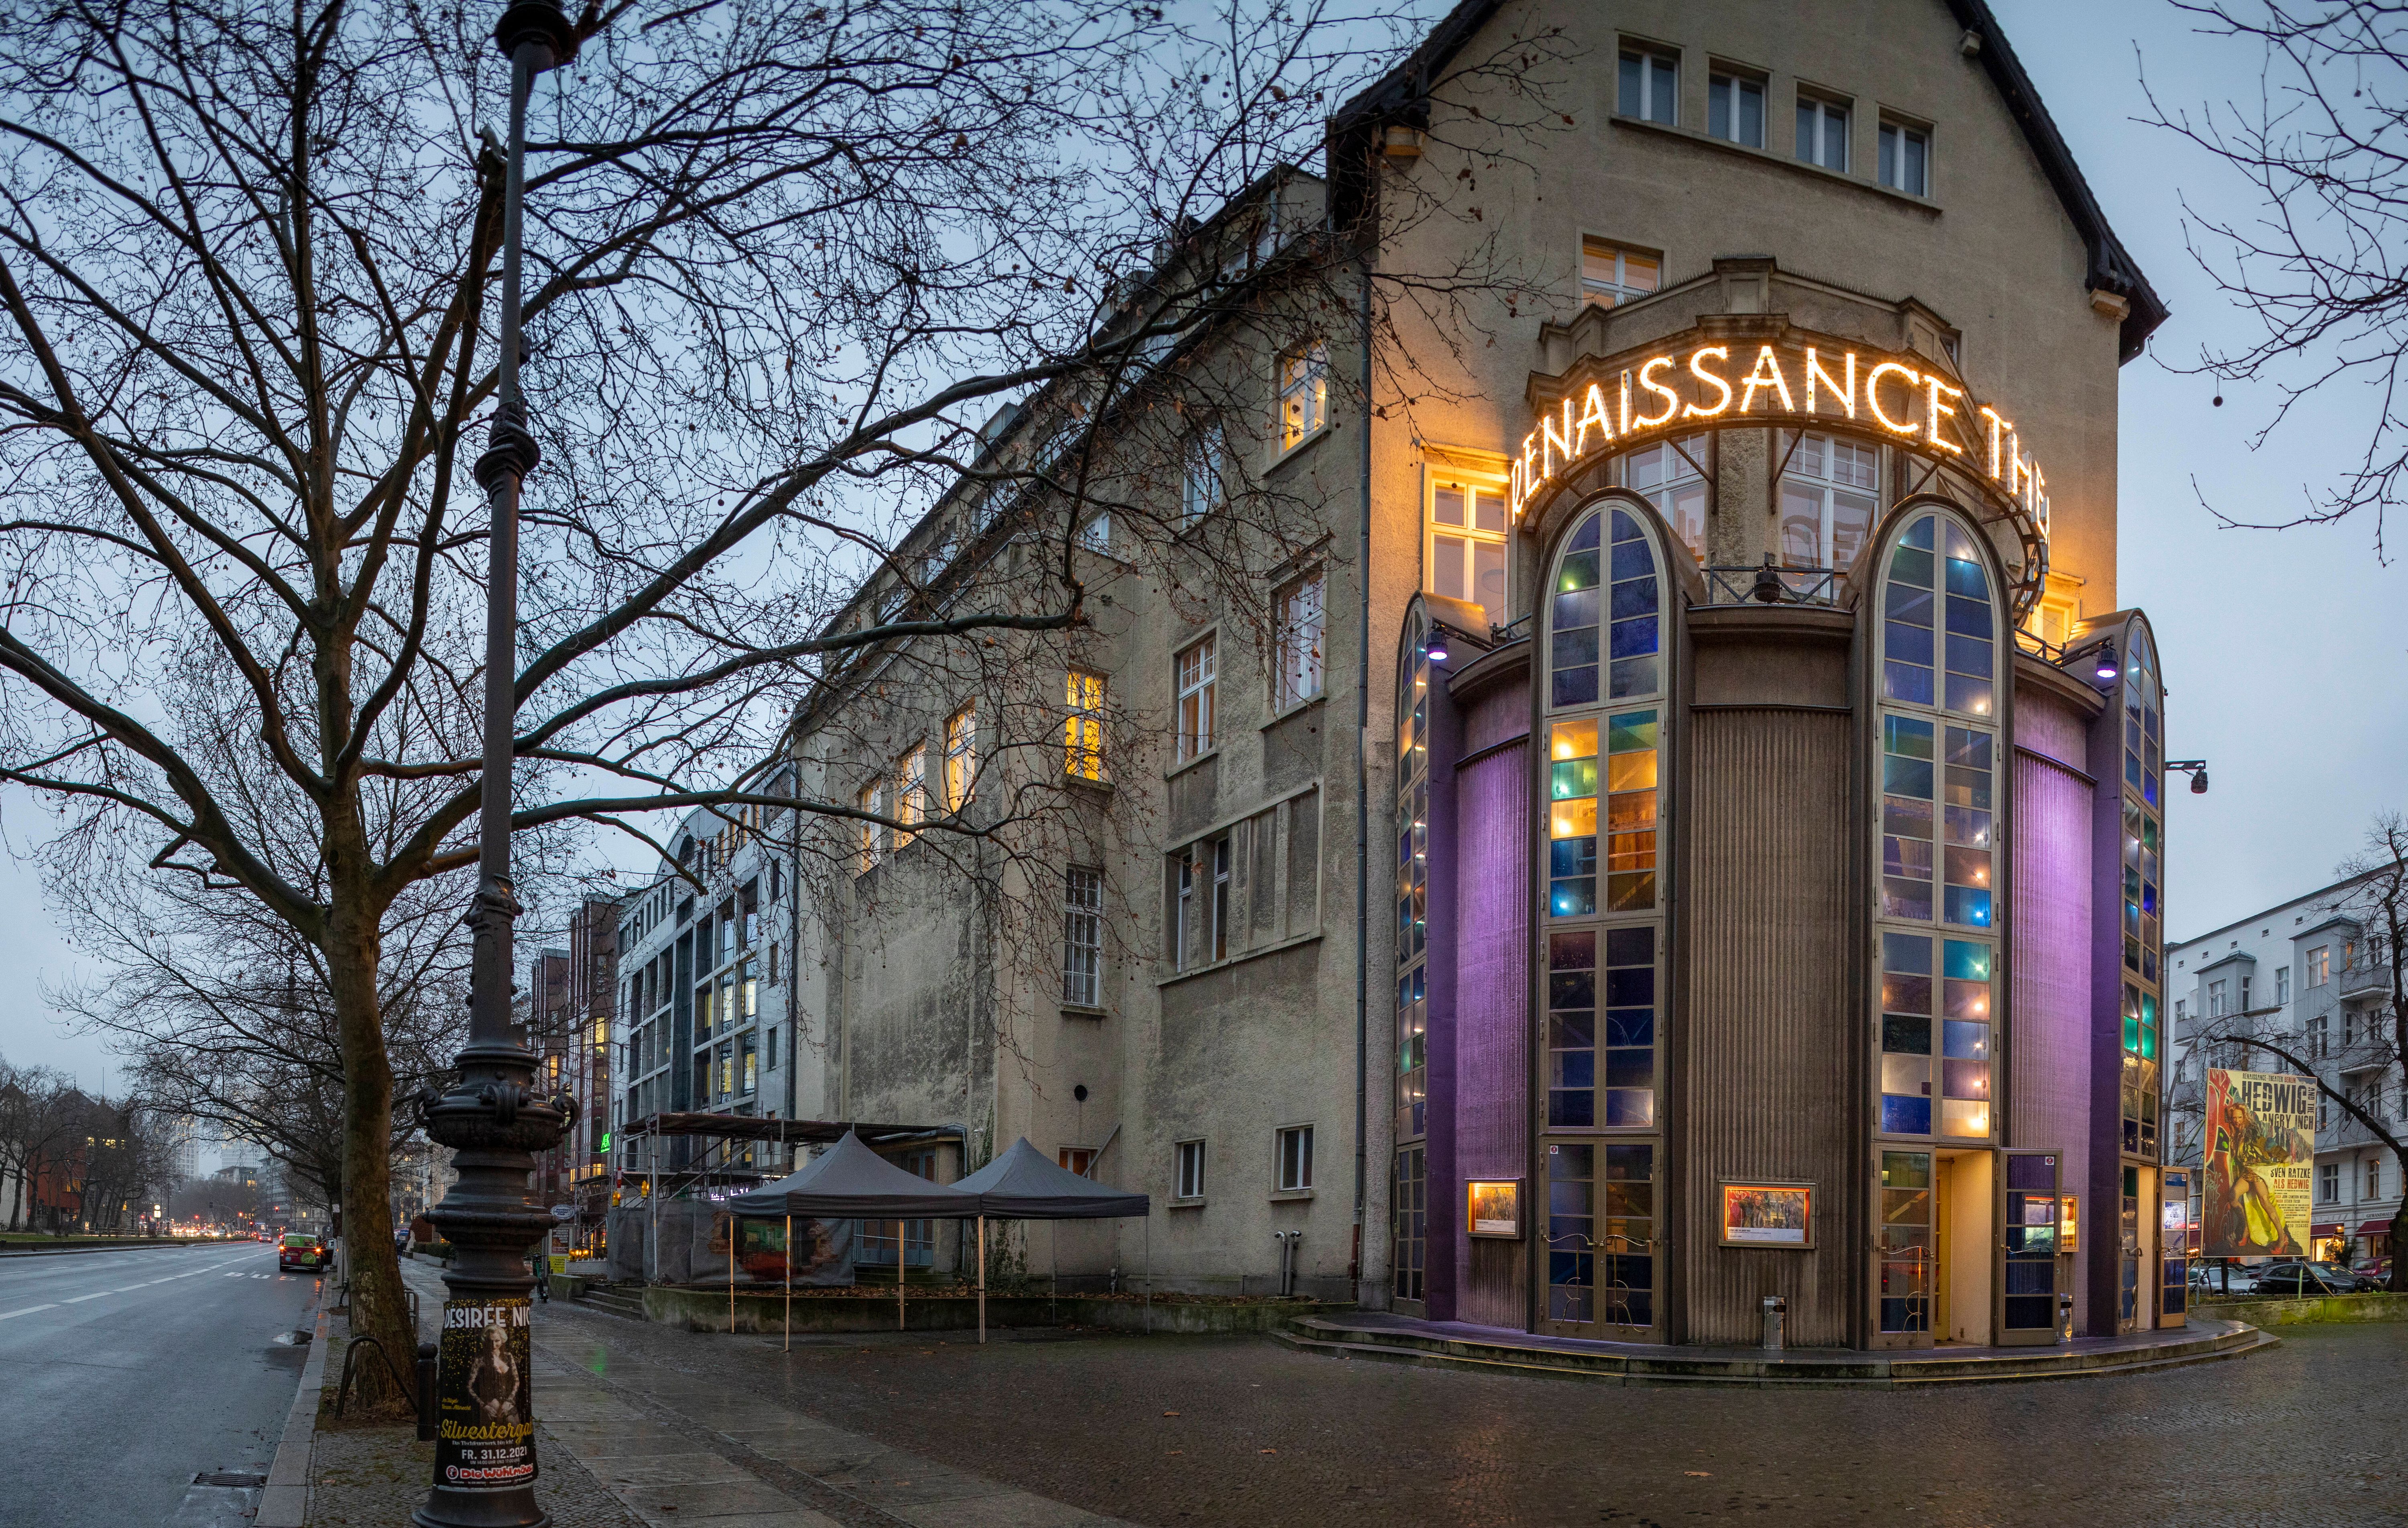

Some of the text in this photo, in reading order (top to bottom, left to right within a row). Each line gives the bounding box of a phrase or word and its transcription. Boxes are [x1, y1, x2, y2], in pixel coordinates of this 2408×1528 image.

[1511, 345, 1964, 526] RENAISSANCE
[2242, 1073, 2283, 1082] RENAISSANCE-THEATER
[2242, 1081, 2307, 1115] HEDWIG
[2262, 1113, 2314, 1130] ANGRY INCH
[2270, 1168, 2310, 1178] SVEN RATZKE
[2274, 1179, 2309, 1189] ALS HEDWIG
[224, 1272, 298, 1281] BUS
[444, 1303, 506, 1328] DÉSIRÉE
[462, 1446, 527, 1459] FR. 31.12.2021
[460, 1468, 482, 1479] Die
